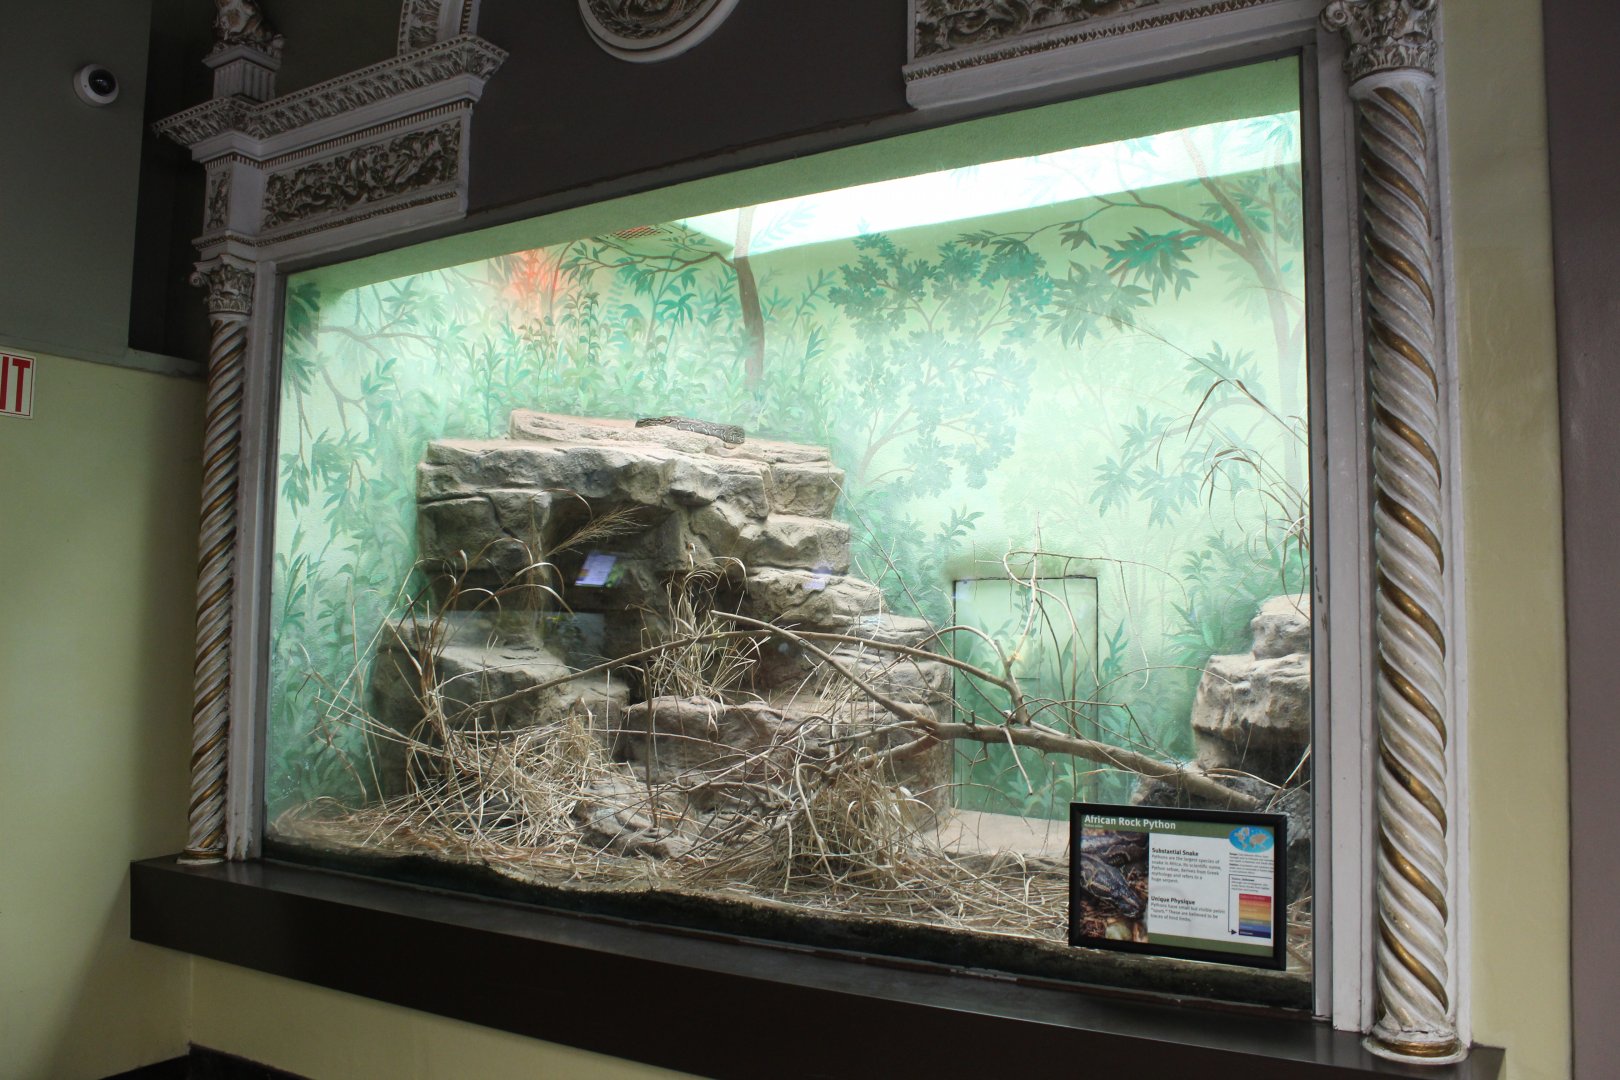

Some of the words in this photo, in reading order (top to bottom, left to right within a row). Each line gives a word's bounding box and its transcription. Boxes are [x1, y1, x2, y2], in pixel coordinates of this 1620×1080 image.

[1084, 814, 1116, 825] African
[1118, 817, 1141, 827] Rock
[1143, 819, 1176, 830] Python
